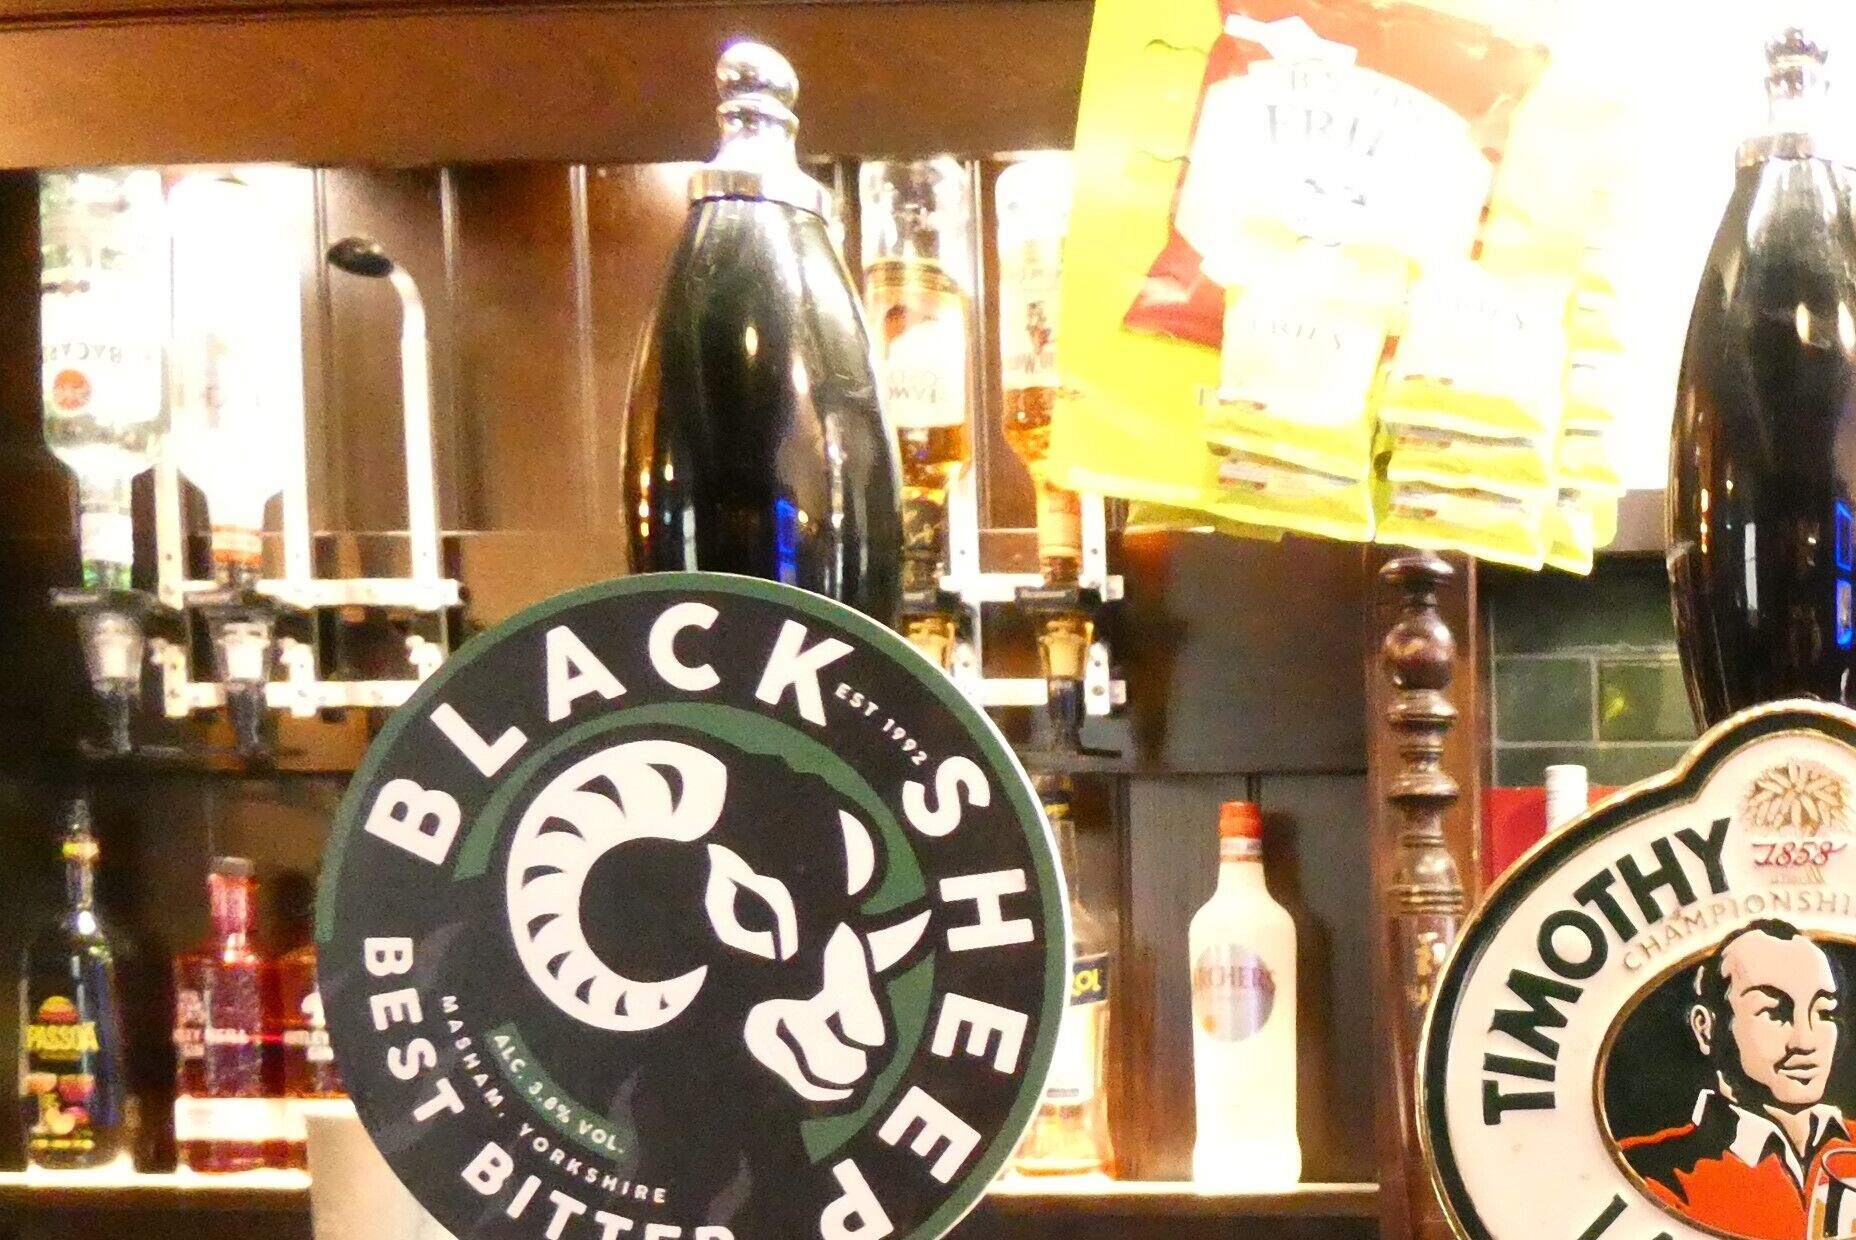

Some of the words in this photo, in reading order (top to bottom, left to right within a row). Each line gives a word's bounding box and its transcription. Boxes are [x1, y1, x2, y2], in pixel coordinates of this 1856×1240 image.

[365, 602, 854, 864] BLACK
[835, 682, 879, 717] EST
[882, 718, 928, 766] 1992
[1751, 840, 1848, 868] 1858
[363, 936, 466, 1122] BEST
[1483, 817, 1731, 1126] TIMOTHY
[441, 995, 505, 1119] MASHAM,
[519, 1122, 667, 1204] YORKSHIRE
